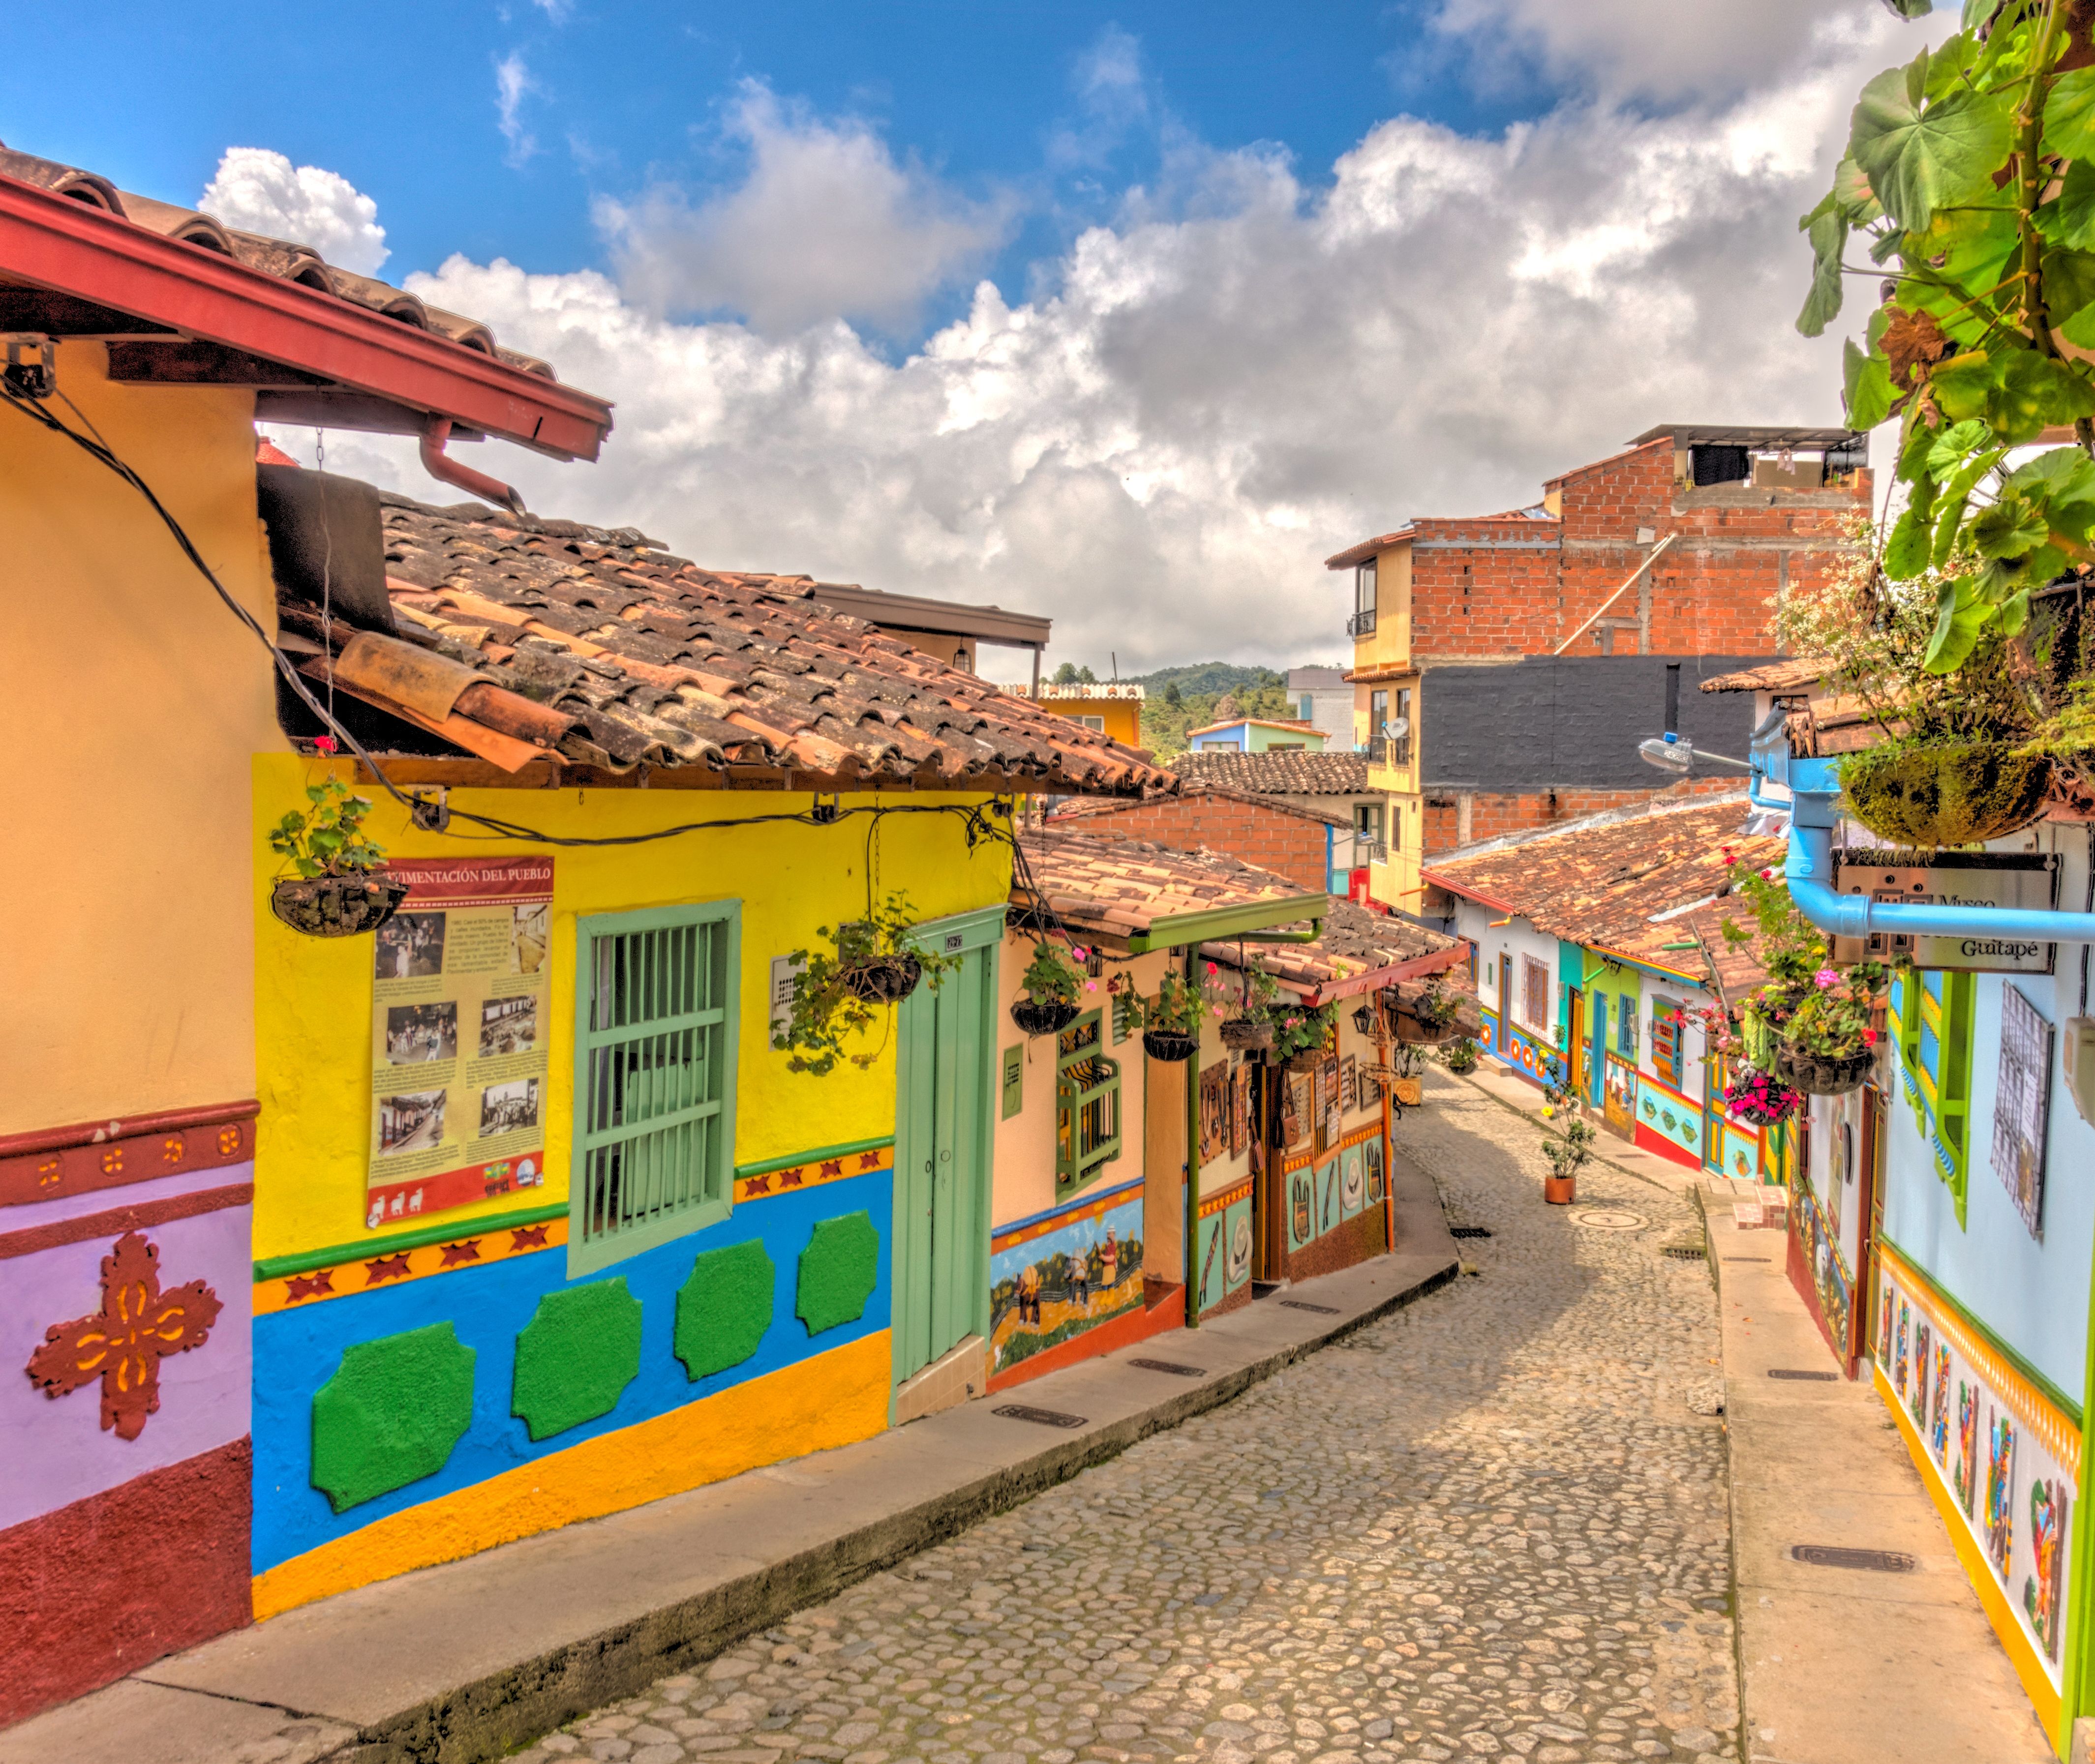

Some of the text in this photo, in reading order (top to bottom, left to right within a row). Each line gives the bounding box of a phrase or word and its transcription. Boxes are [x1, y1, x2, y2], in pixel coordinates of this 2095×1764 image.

[385, 867, 551, 884] VIMENTACIÓN DEL PUEBLO
[1961, 940, 2038, 960] Guatapé
